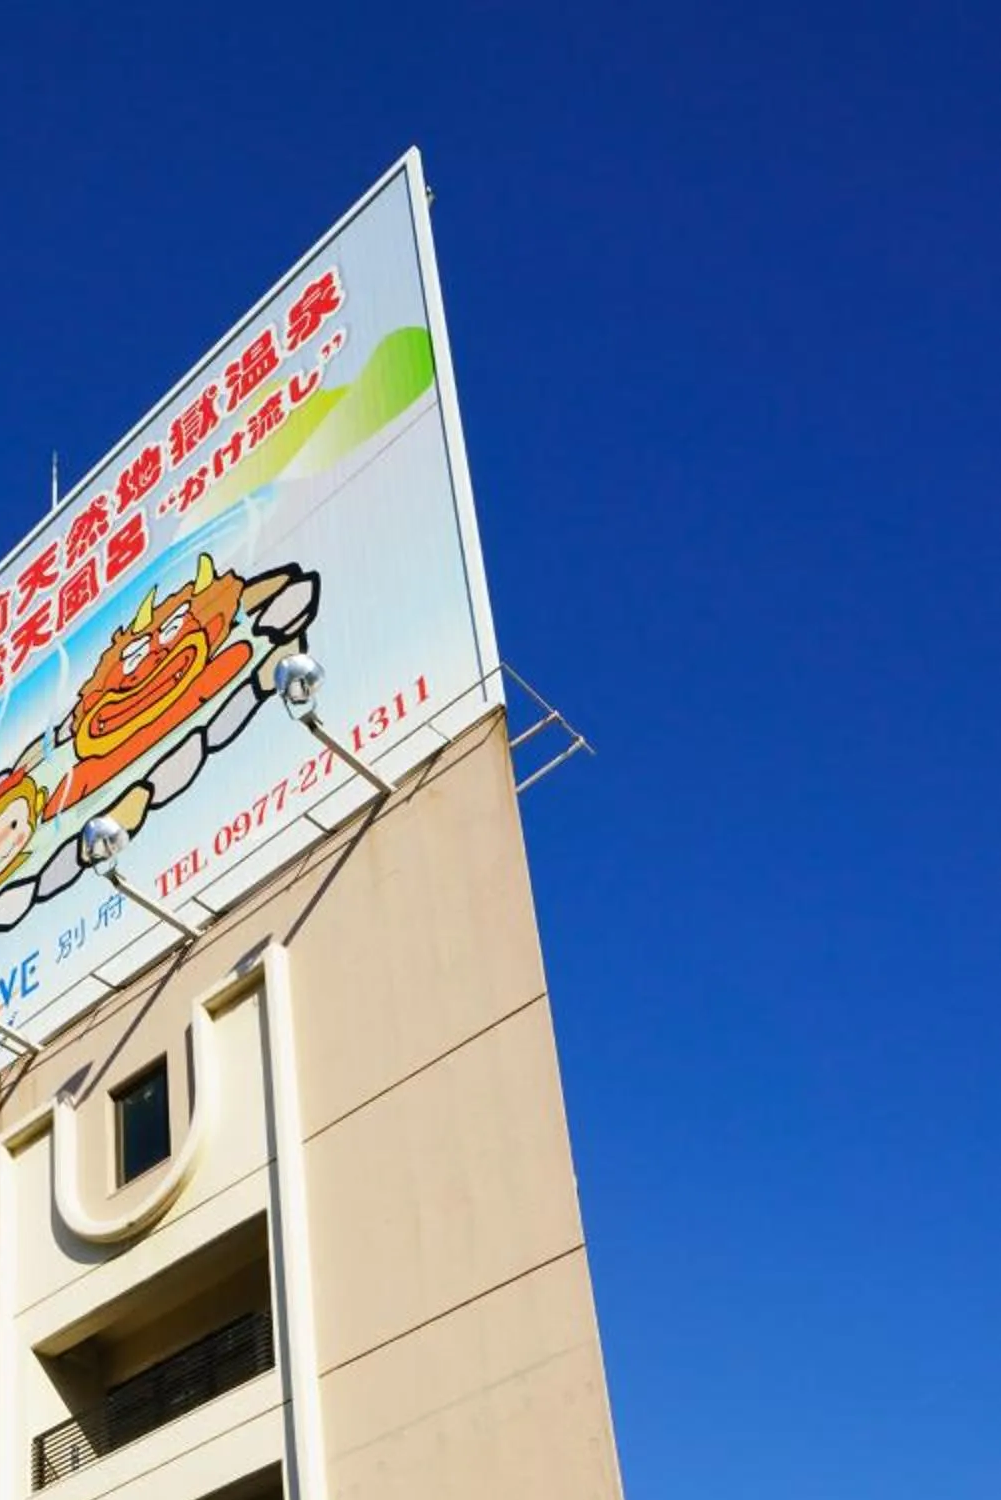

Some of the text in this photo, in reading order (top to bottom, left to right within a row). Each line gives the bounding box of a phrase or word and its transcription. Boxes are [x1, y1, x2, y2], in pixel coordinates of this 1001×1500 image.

[155, 674, 431, 900] TEL 0977-271311
[55, 893, 127, 964] 別府
